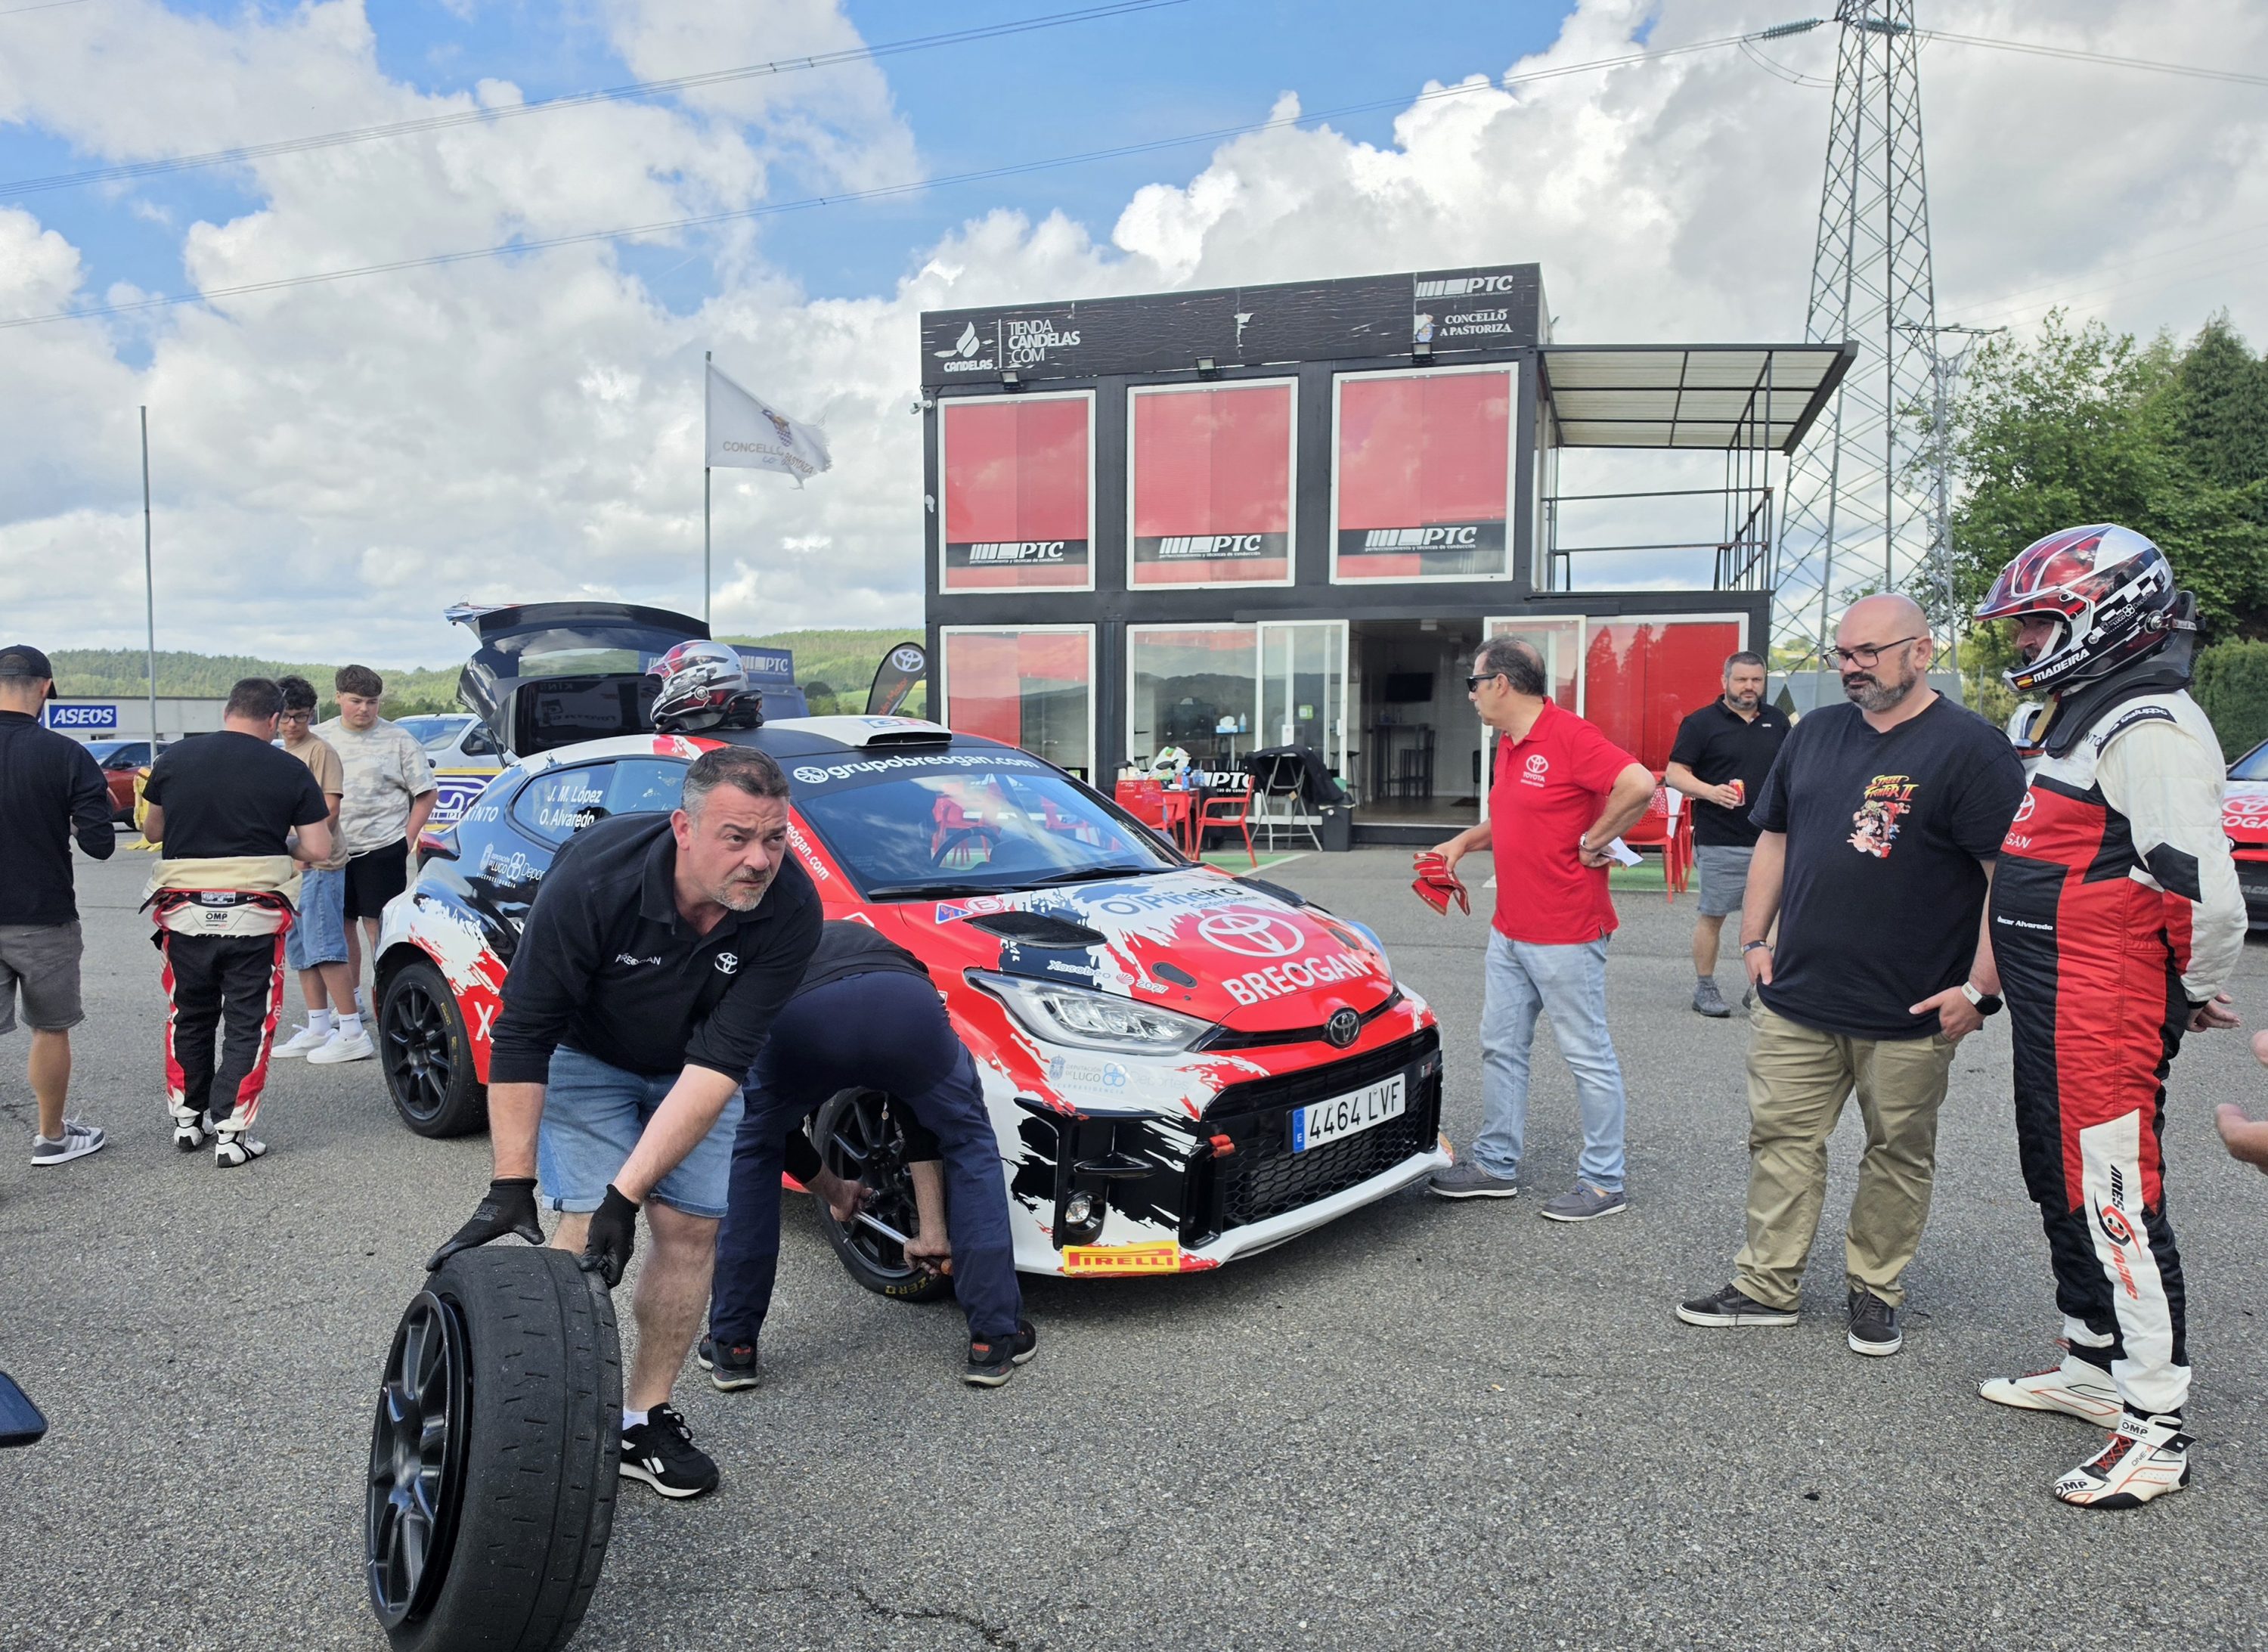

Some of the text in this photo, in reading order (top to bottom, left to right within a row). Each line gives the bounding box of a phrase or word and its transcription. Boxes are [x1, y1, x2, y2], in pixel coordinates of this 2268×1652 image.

[1466, 275, 1514, 293] PTC
[1445, 311, 1507, 324] CONCELLO
[1008, 319, 1053, 336] TIENDA
[1439, 324, 1514, 336] A PASTORIZA
[1009, 331, 1081, 350] CANDELAS
[944, 359, 993, 372] CANDELAS
[1212, 535, 1262, 553] PTC
[1422, 526, 1477, 545] PTC
[1018, 541, 1064, 559] PTC
[765, 658, 789, 672] PTC
[2033, 649, 2090, 683] MADEIRA
[53, 708, 113, 724] ASEOS
[828, 755, 1040, 780] grupobreogan.com
[1523, 771, 1545, 783] TOYOTA
[547, 786, 604, 804] J. M. López
[539, 808, 595, 828] O. Alvaredo
[2005, 832, 2032, 849] GAN
[491, 861, 508, 874] LUGO
[1047, 959, 1167, 993] Xacobeo 2027
[1221, 953, 1373, 1006] BREOGAN
[1073, 1071, 1101, 1083] LUGO
[1297, 1080, 1401, 1143] E 4464 LVF
[1068, 1248, 1174, 1267] PIRELLI
[2121, 1421, 2149, 1436] OMP
[2053, 1480, 2089, 1498] OMP
